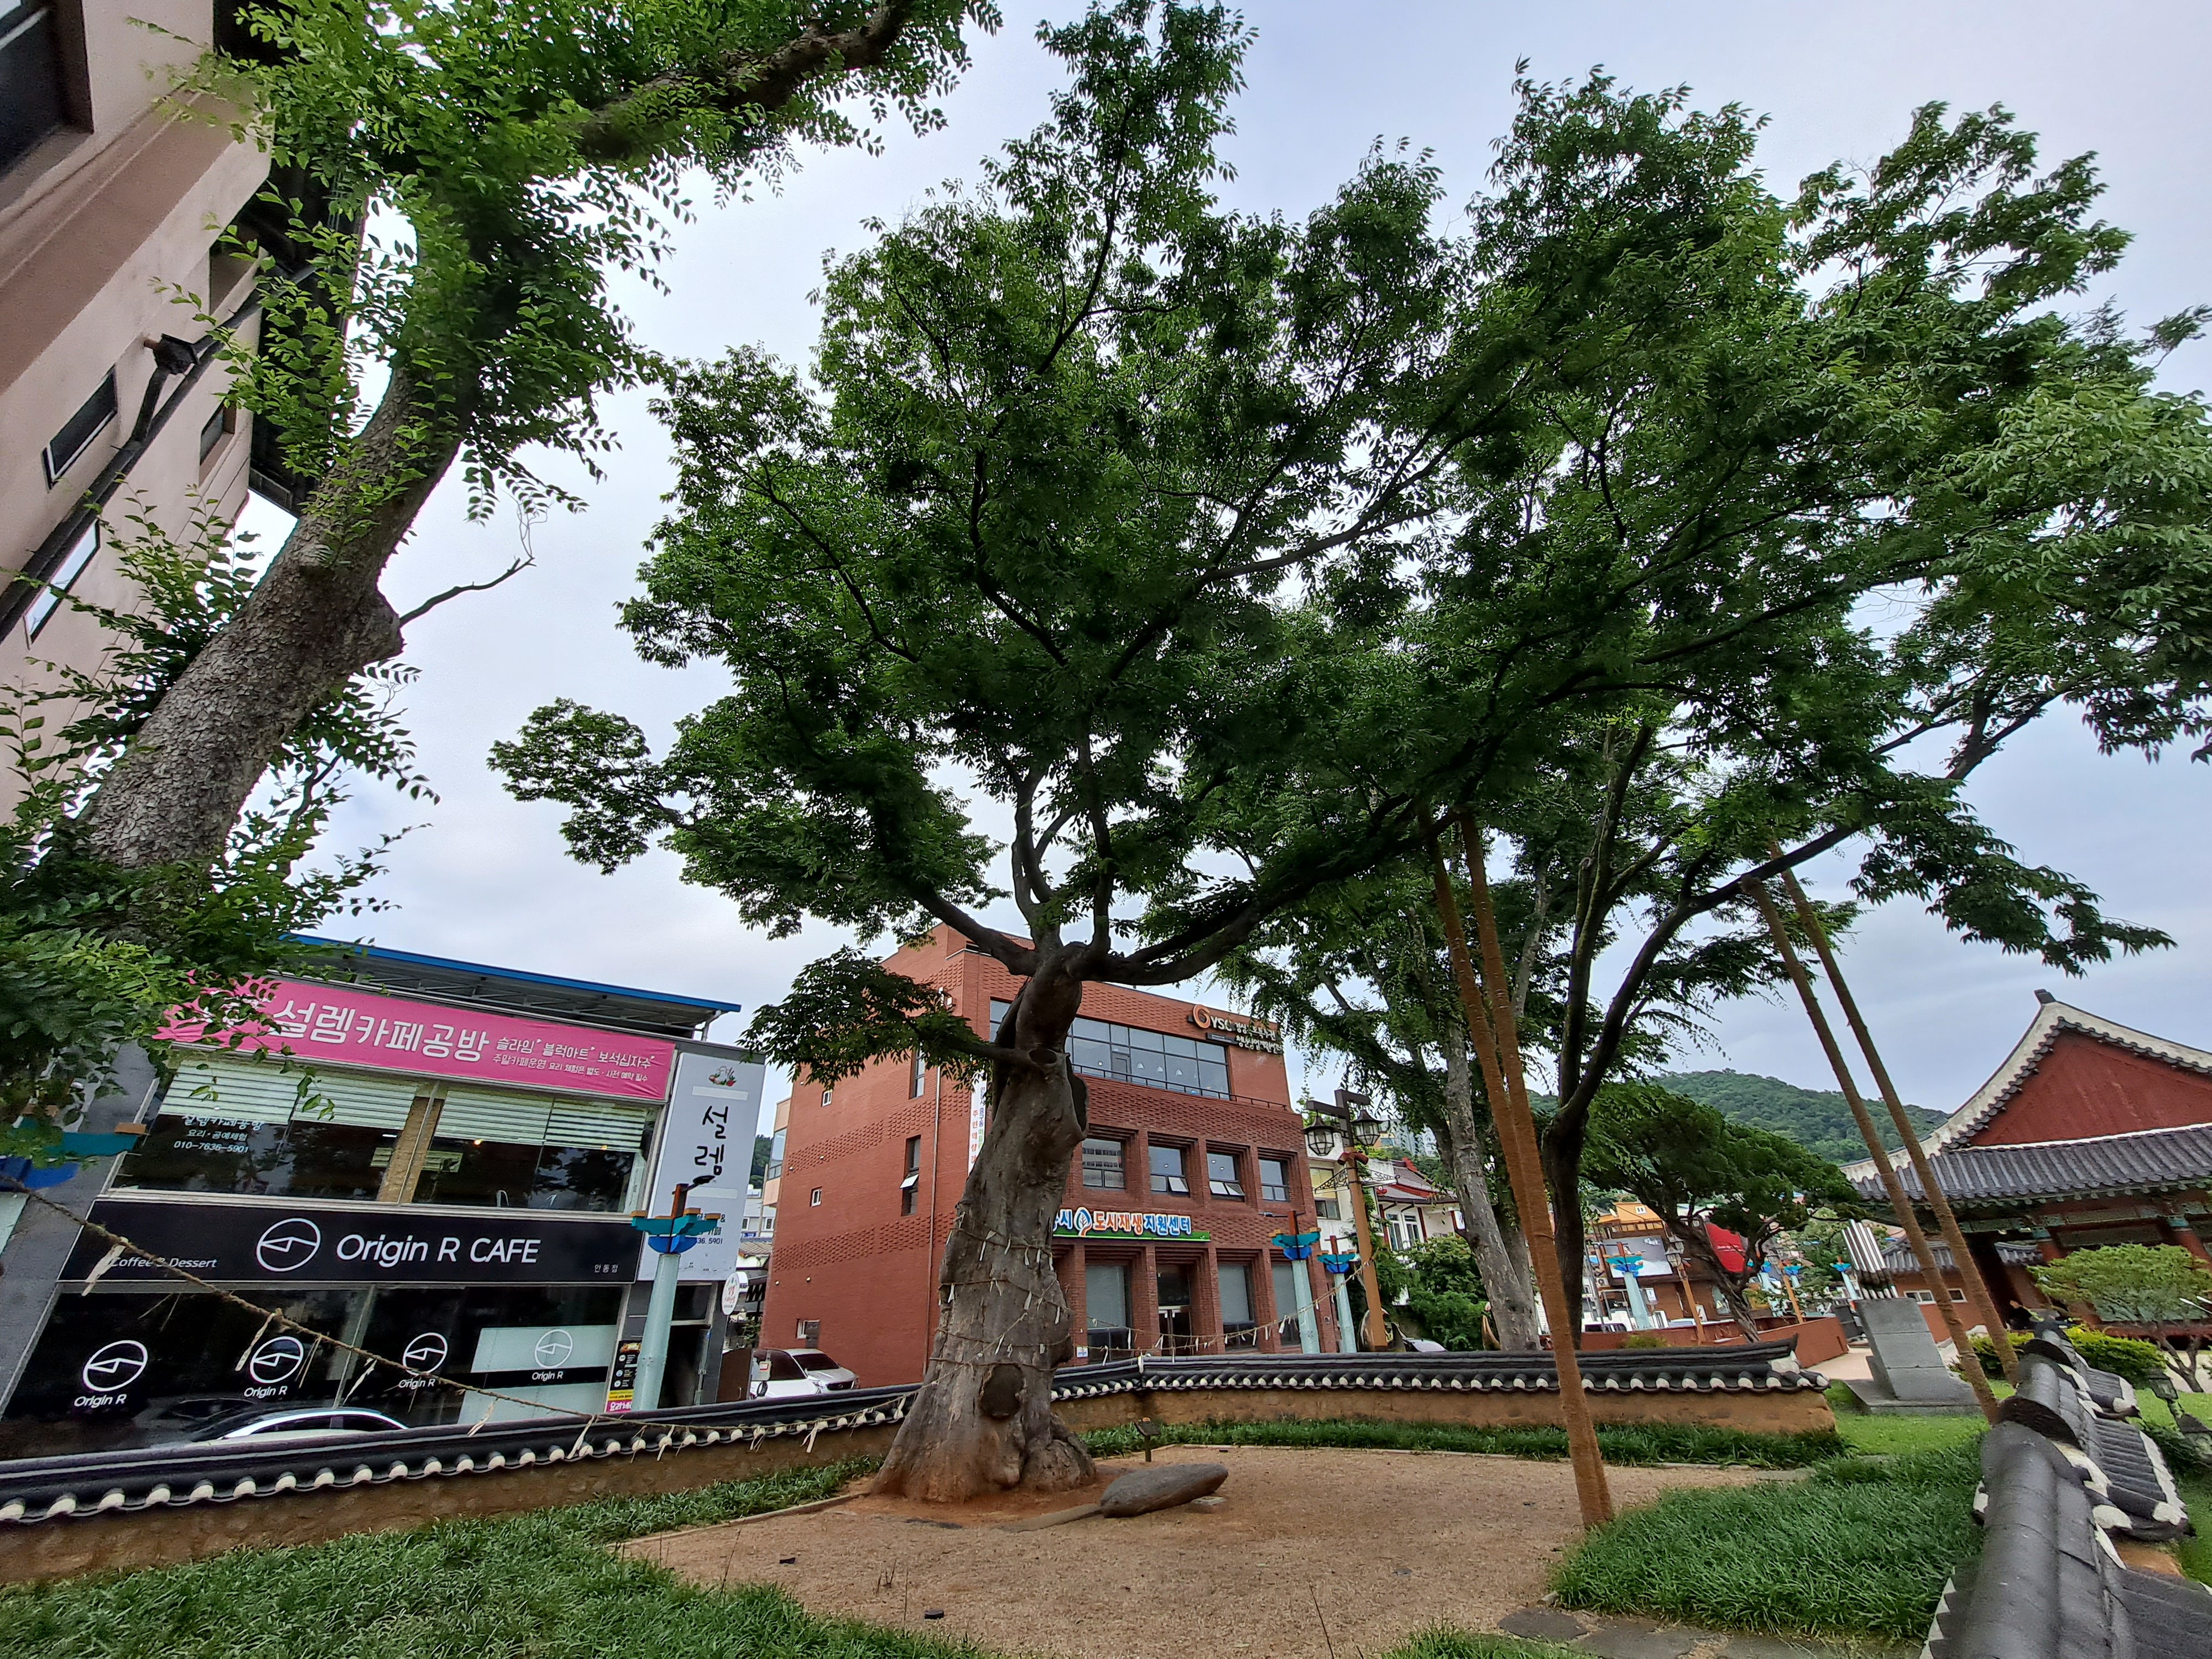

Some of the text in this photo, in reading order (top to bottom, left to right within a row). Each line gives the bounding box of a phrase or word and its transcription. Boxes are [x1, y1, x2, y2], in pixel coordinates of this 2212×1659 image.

[267, 1000, 490, 1062] 설렘카페공방
[496, 1037, 652, 1070] 슬라임 블럭아트 보석십자수
[492, 1053, 547, 1070] 주말카페운영
[173, 1140, 250, 1154] 010-7636-5901
[693, 1105, 729, 1176] 설렘
[1092, 1211, 1192, 1236] 도시재생지원센터
[336, 1234, 541, 1267] Origin R CAFE
[111, 1256, 153, 1267] Coffee
[169, 1258, 218, 1269] Dessert
[594, 1264, 619, 1274] 안동점
[427, 1378, 436, 1388] R
[531, 1370, 563, 1382] Origin R
[244, 1385, 288, 1399] Origin R
[74, 1394, 127, 1409] Origin R
